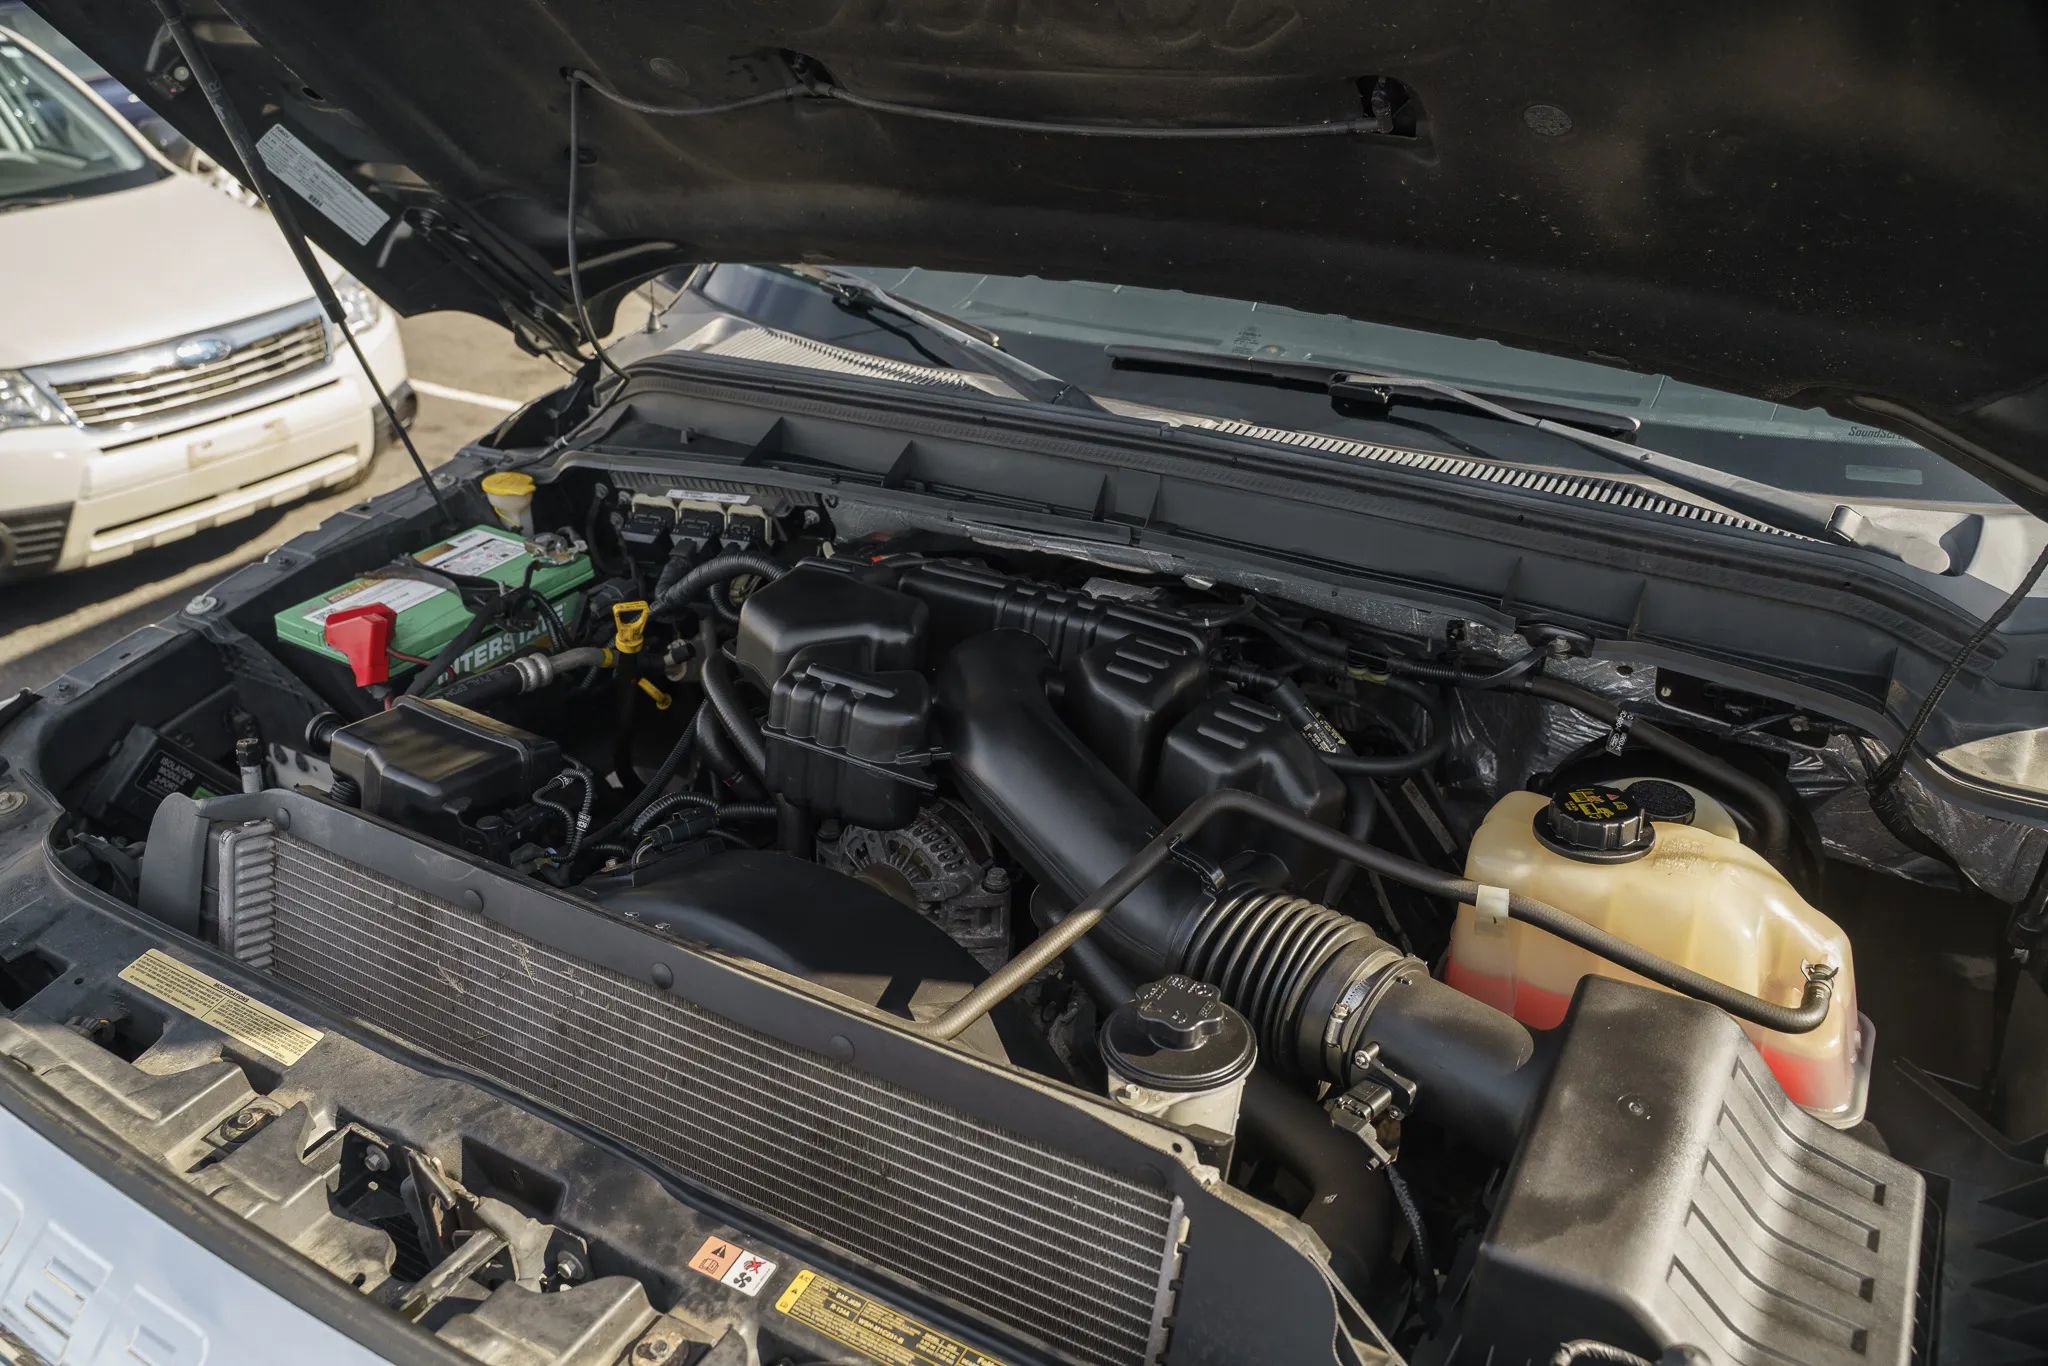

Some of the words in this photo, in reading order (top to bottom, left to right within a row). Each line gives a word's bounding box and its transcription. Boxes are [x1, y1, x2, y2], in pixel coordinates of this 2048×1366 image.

[157, 766, 187, 786] MODULE
[160, 756, 196, 780] ISOLATION
[213, 982, 249, 1003] MODIFICATIONS
